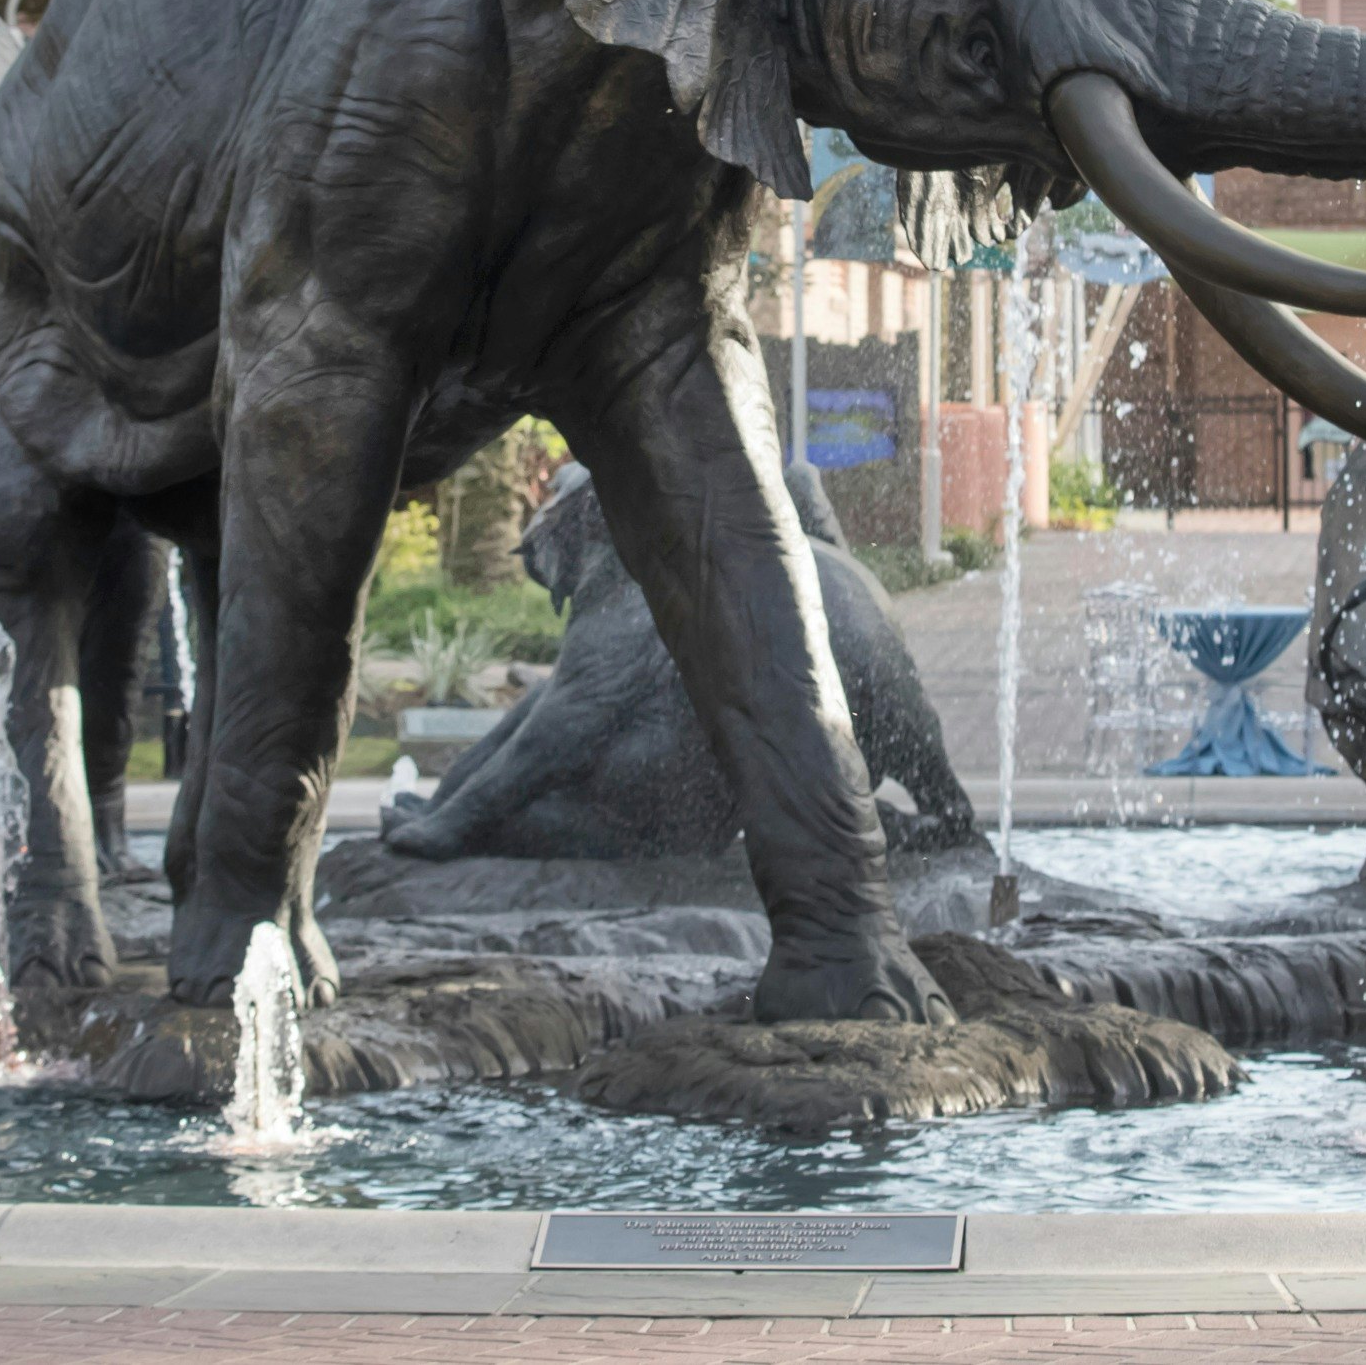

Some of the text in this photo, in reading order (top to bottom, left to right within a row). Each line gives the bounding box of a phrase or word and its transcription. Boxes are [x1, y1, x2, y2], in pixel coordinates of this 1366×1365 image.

[624, 1221, 652, 1229] The
[851, 1221, 891, 1230] Plaza
[798, 1229, 860, 1239] memory
[700, 1253, 740, 1262] April
